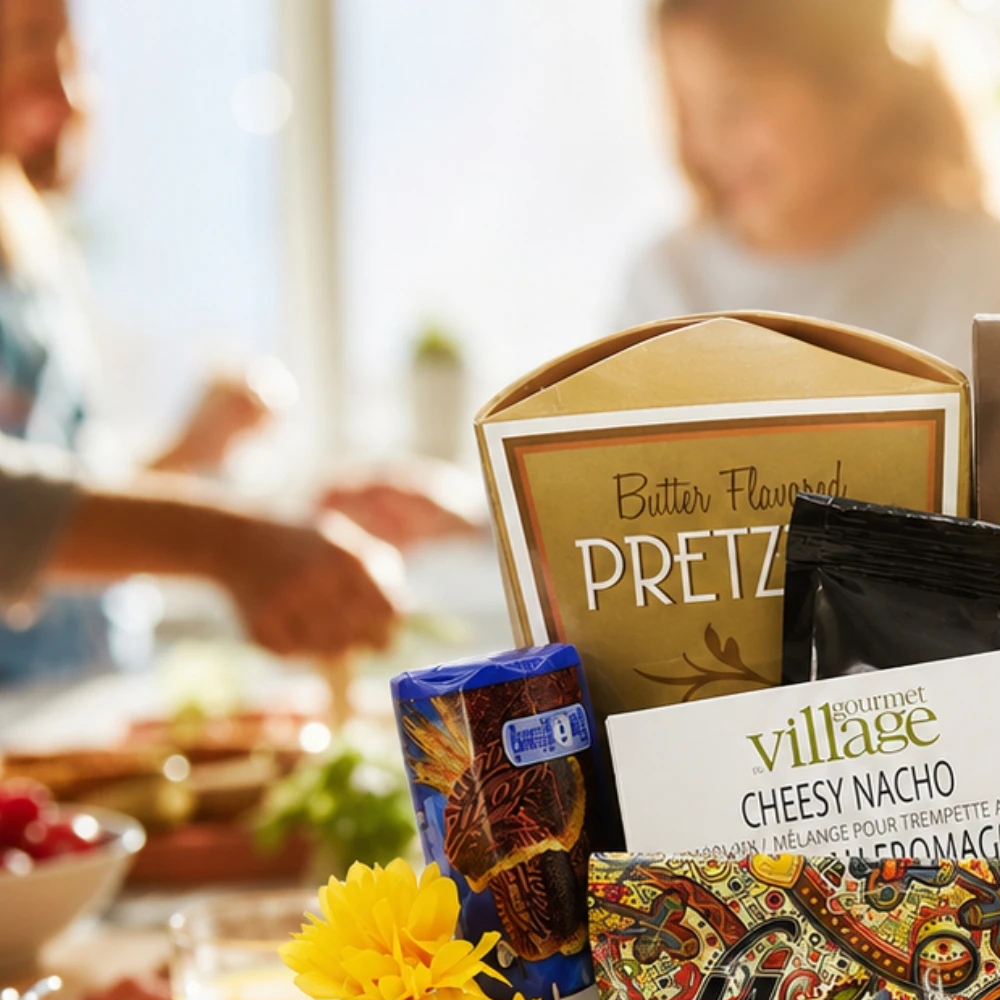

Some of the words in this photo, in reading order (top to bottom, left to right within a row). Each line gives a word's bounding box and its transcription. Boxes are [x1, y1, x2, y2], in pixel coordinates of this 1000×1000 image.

[612, 472, 712, 520] Butter
[574, 524, 790, 612] PRETZ
[831, 685, 928, 723] gourmet
[746, 702, 941, 772] village
[741, 776, 845, 828] CHEESY
[852, 760, 955, 811] NACHO
[773, 824, 848, 850] MÉLANGE
[853, 816, 898, 840] POUR
[900, 800, 990, 829] TREMPETTE
